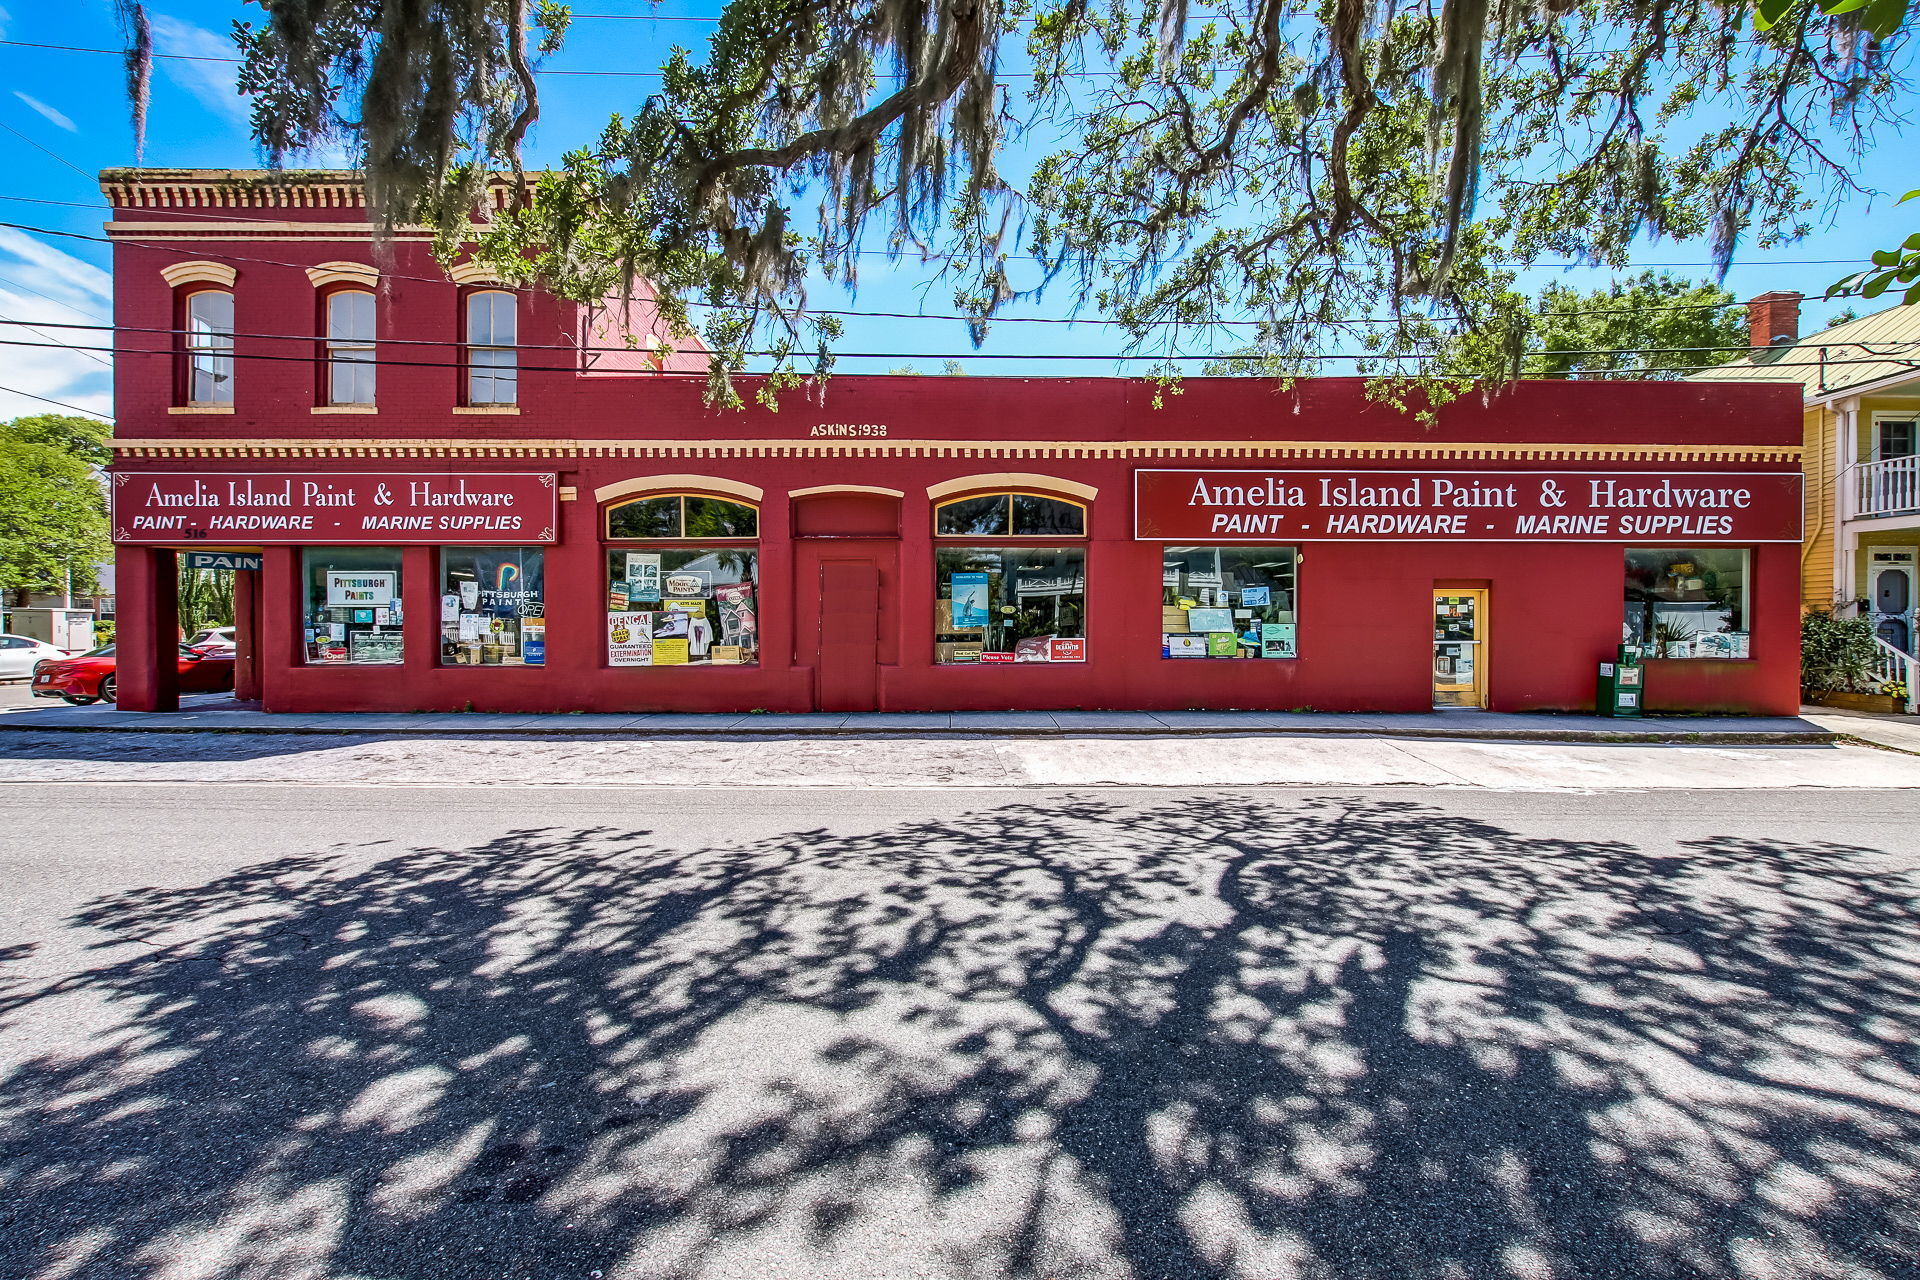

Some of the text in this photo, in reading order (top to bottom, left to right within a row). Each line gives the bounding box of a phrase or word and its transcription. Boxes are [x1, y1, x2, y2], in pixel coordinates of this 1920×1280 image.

[810, 423, 888, 437] ASKINS 1938
[145, 479, 514, 507] Amelia Island Paint & Hardware
[1187, 477, 1751, 509] Amelia Island Paint & Hardware
[132, 515, 188, 530] PAINT
[209, 515, 314, 530] HARDWARE
[361, 515, 434, 530] MARINE
[438, 515, 523, 530] SUPPLIES
[1211, 513, 1285, 534] PAINT
[1326, 514, 1468, 534] HARDWARE
[1515, 515, 1610, 534] MARINE
[1618, 515, 1734, 535] SUPPLIES
[184, 528, 207, 539] 516
[194, 555, 263, 569] PAIN
[334, 577, 385, 588] PITTSBURGH
[344, 590, 374, 600] PAINTS
[610, 649, 652, 658] EXTERMINATION
